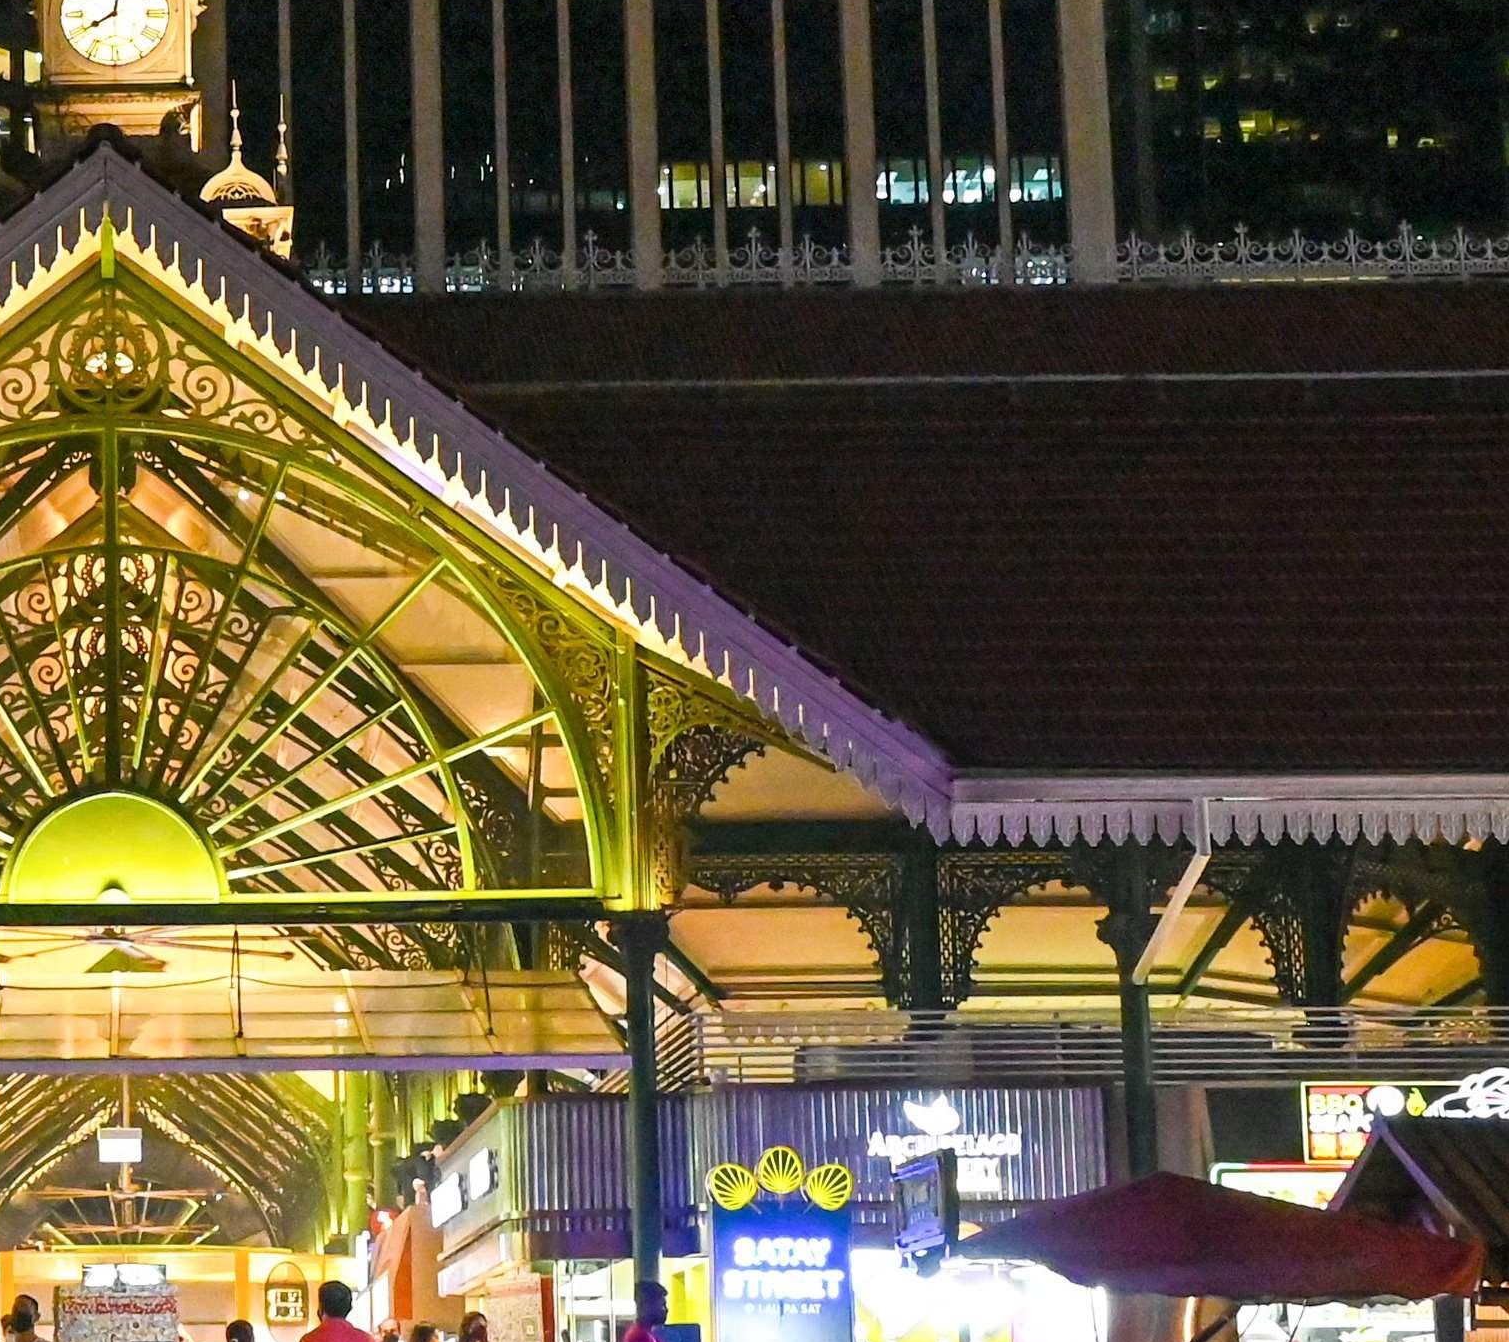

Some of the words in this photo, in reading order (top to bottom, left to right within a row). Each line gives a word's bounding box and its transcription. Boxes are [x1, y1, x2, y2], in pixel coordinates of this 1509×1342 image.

[1309, 1094, 1363, 1114] BBQ
[733, 1237, 832, 1267] SATAY
[783, 1303, 798, 1314] PA
[801, 1303, 821, 1314] SAT
